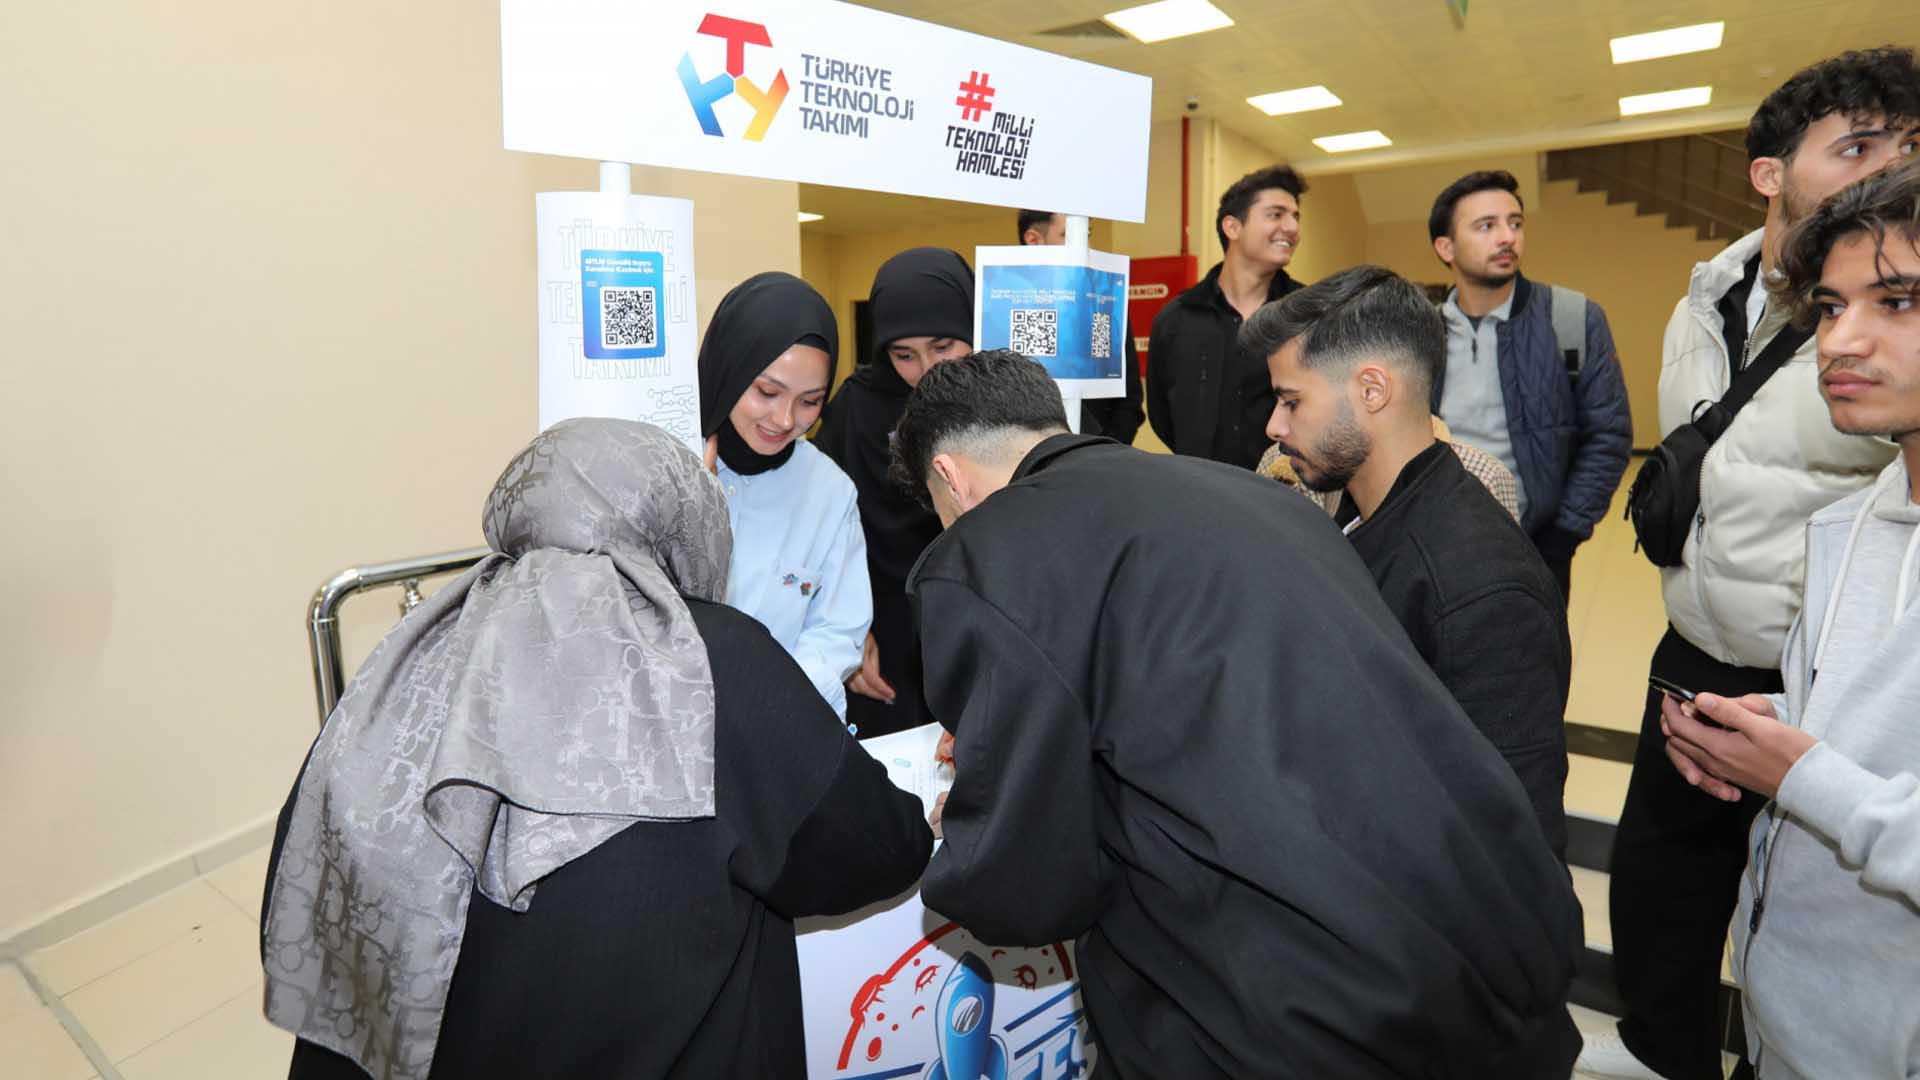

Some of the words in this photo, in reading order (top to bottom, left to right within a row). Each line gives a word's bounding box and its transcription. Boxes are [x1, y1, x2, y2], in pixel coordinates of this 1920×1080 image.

[800, 53, 893, 92] TÜRKİYE
[799, 80, 915, 121] TEKNOLOJİ
[799, 107, 869, 138] TAKIMI
[945, 125, 1030, 159] TEKNOLOJİ
[955, 150, 1026, 180] HAMLESİ
